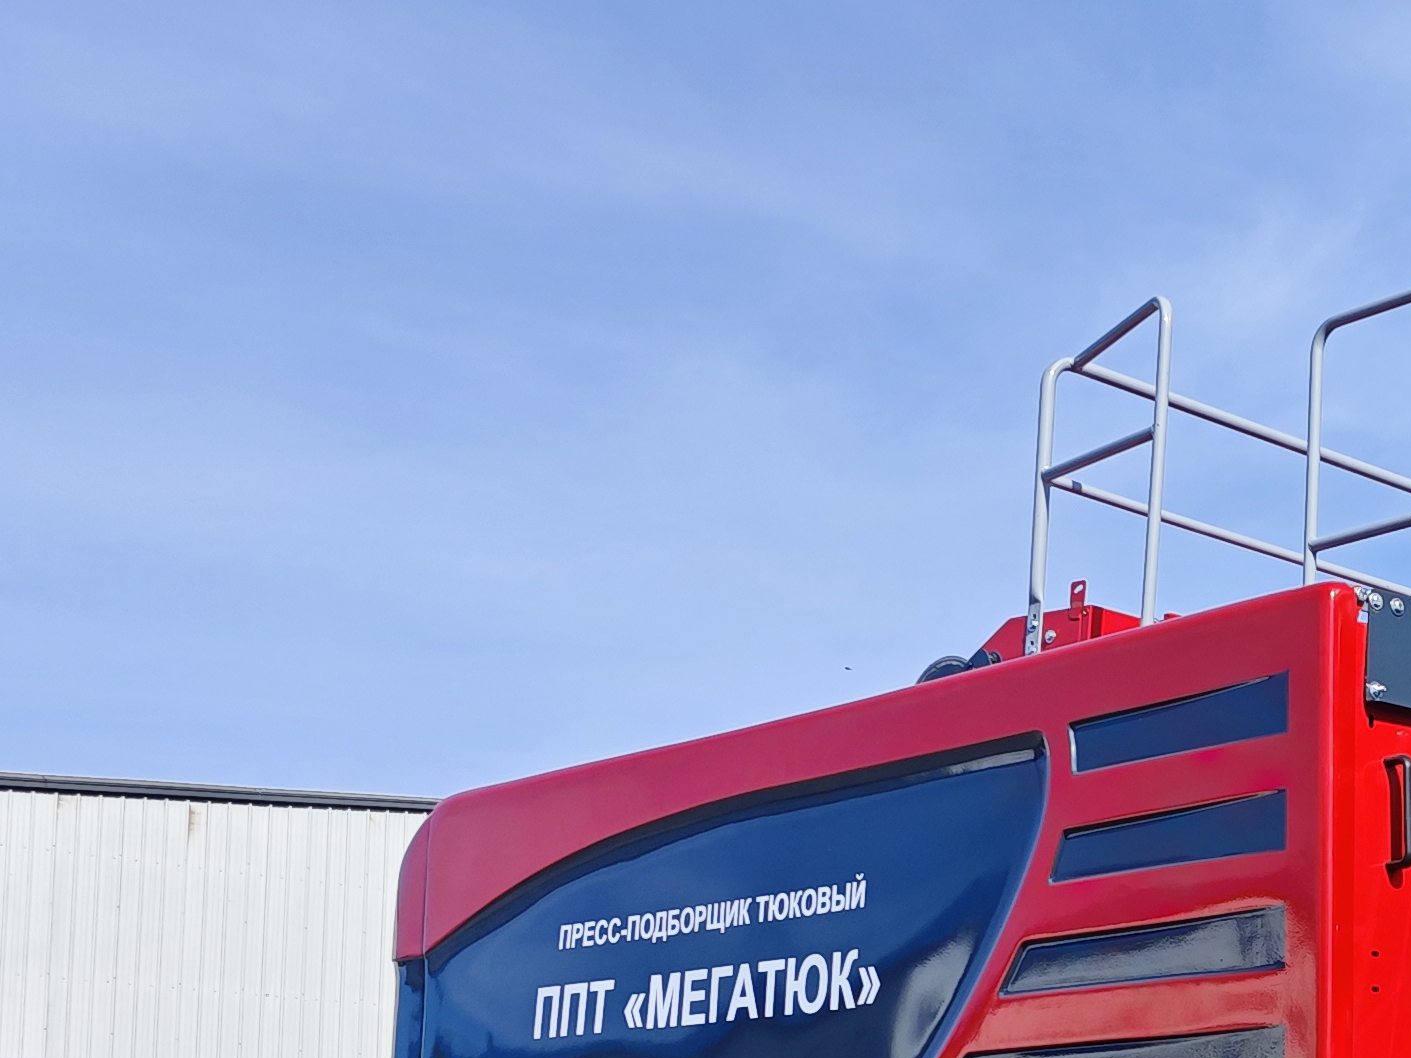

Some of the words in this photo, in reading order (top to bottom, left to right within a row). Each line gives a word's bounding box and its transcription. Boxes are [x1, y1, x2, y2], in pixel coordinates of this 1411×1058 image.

[558, 897, 753, 950] ПРЕСС-ПОДБОРЩИК
[755, 872, 867, 923] ТЮКОВЫЙ
[533, 979, 616, 1040] ППТ
[623, 948, 881, 1030] «МЕГАТЮК»
